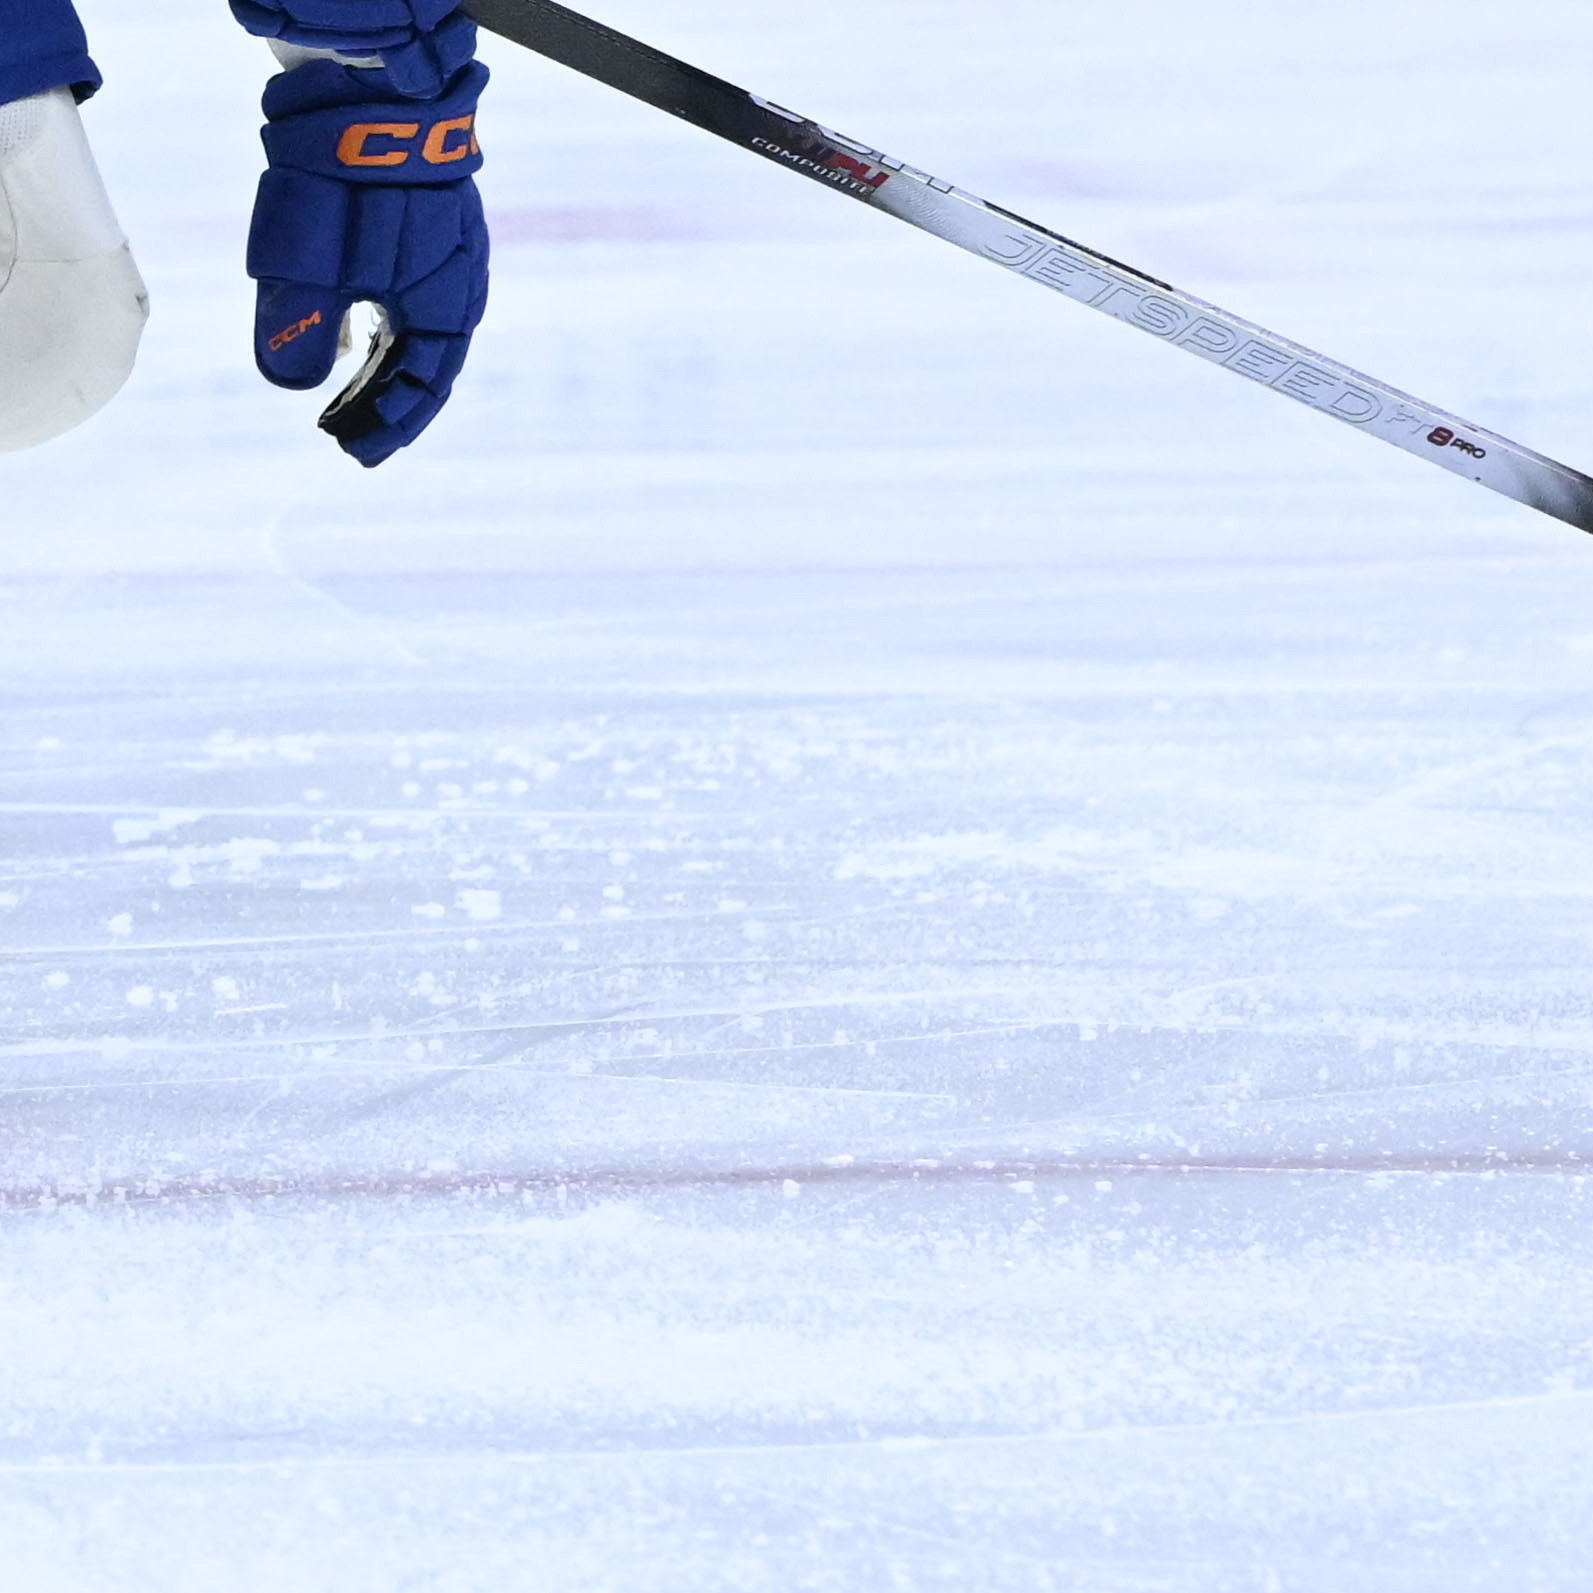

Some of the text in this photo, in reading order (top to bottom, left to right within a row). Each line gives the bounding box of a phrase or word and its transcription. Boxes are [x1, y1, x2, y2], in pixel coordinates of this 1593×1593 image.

[336, 114, 475, 166] CC
[268, 310, 322, 351] CCM
[981, 233, 1383, 425] JETSPEED
[1450, 437, 1487, 459] PRO
